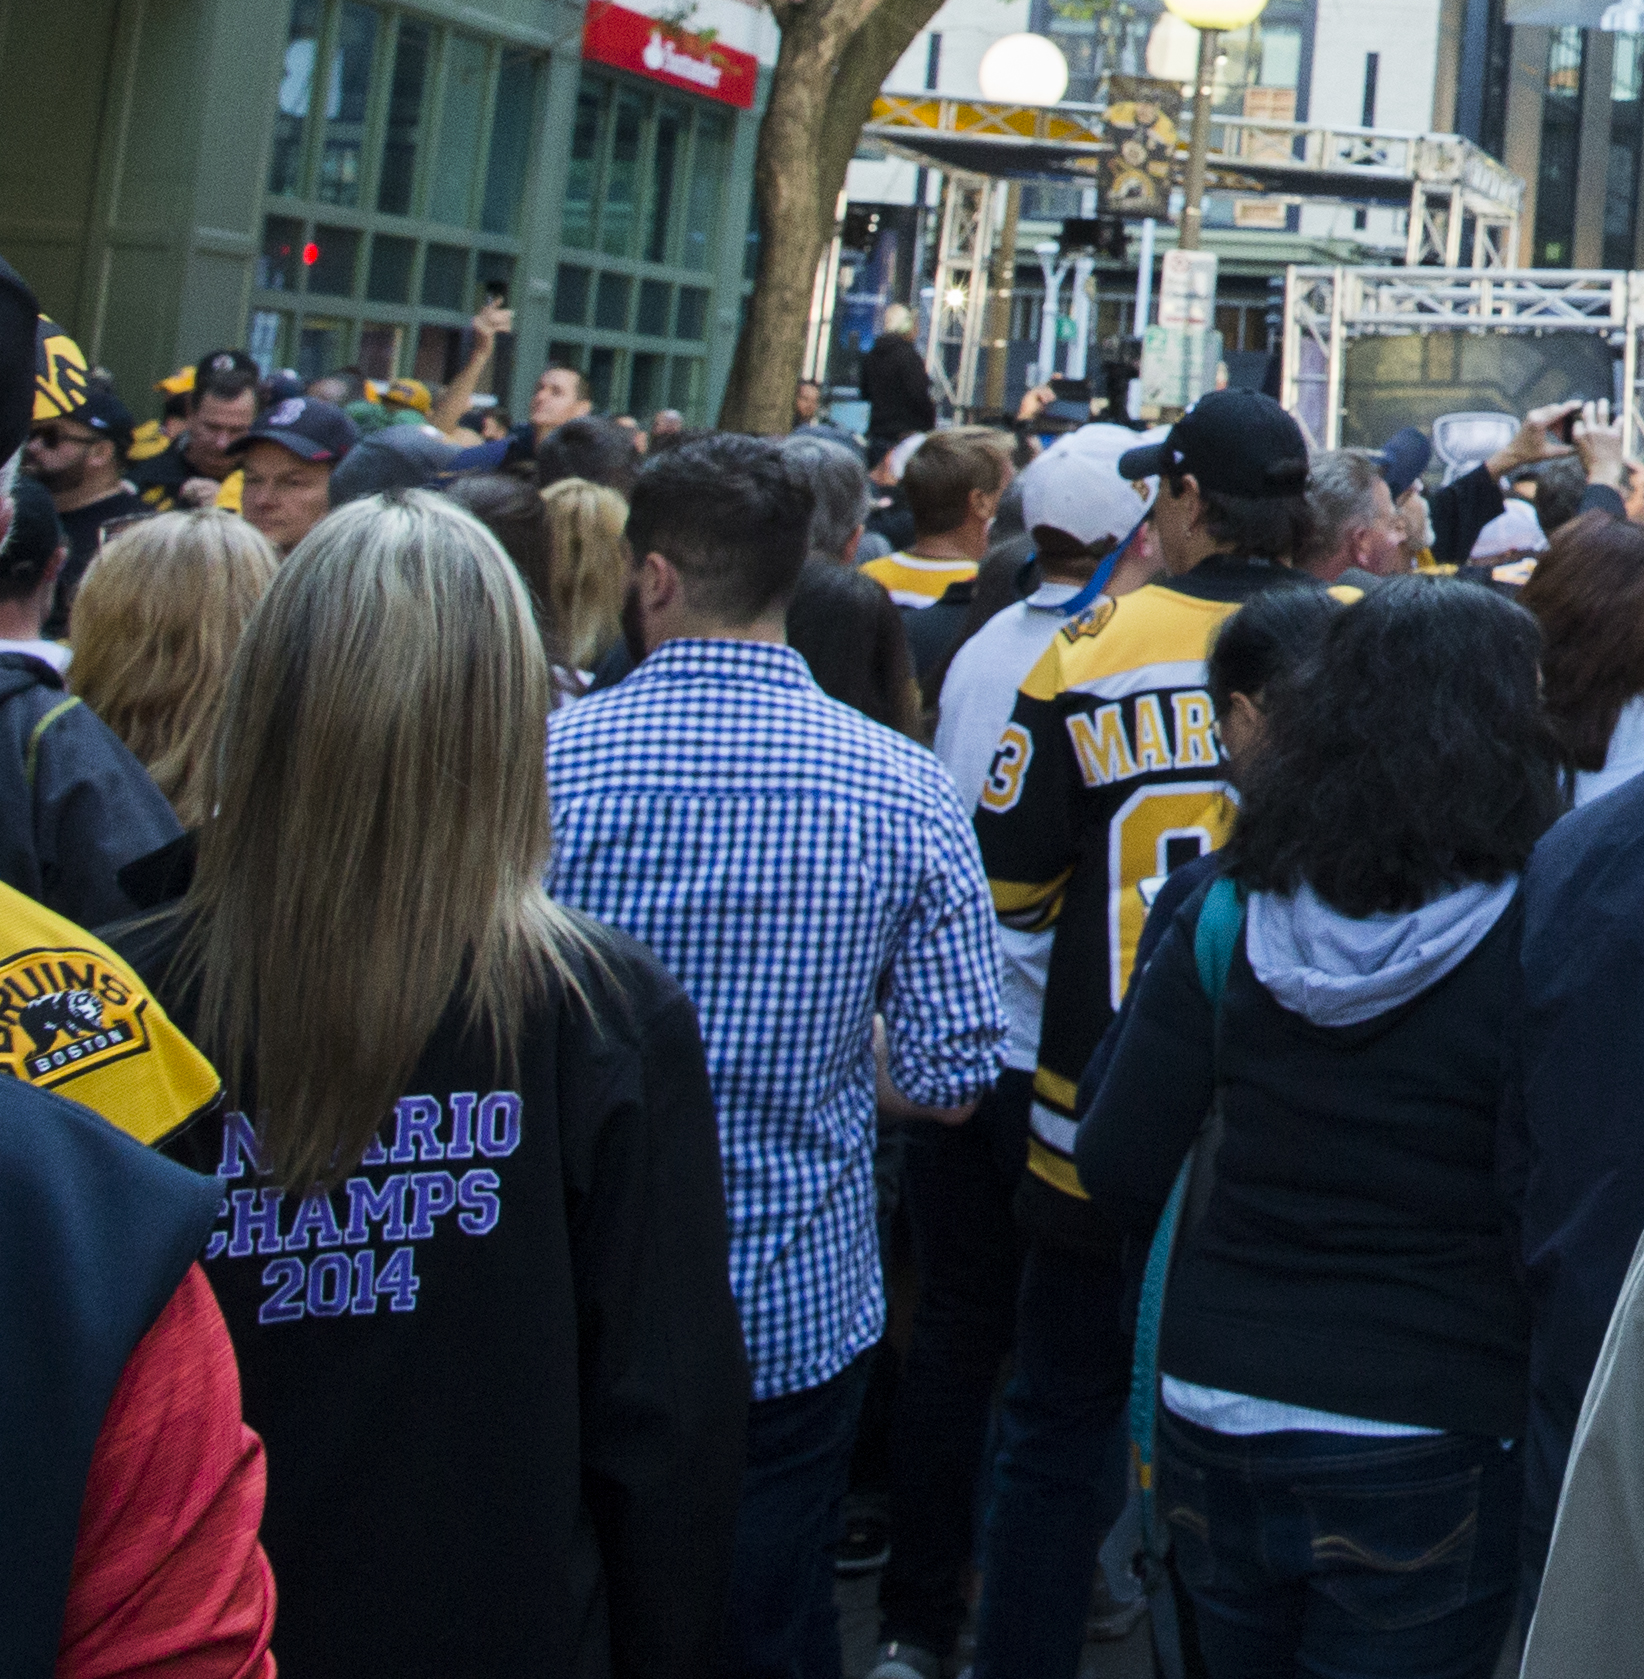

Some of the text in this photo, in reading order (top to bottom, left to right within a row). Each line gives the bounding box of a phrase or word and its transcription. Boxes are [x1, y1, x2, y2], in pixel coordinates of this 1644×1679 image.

[1065, 688, 1230, 788] MAR
[34, 1028, 125, 1073] BOSTON
[216, 1090, 524, 1178] NRIO
[258, 1246, 420, 1325] 2014
